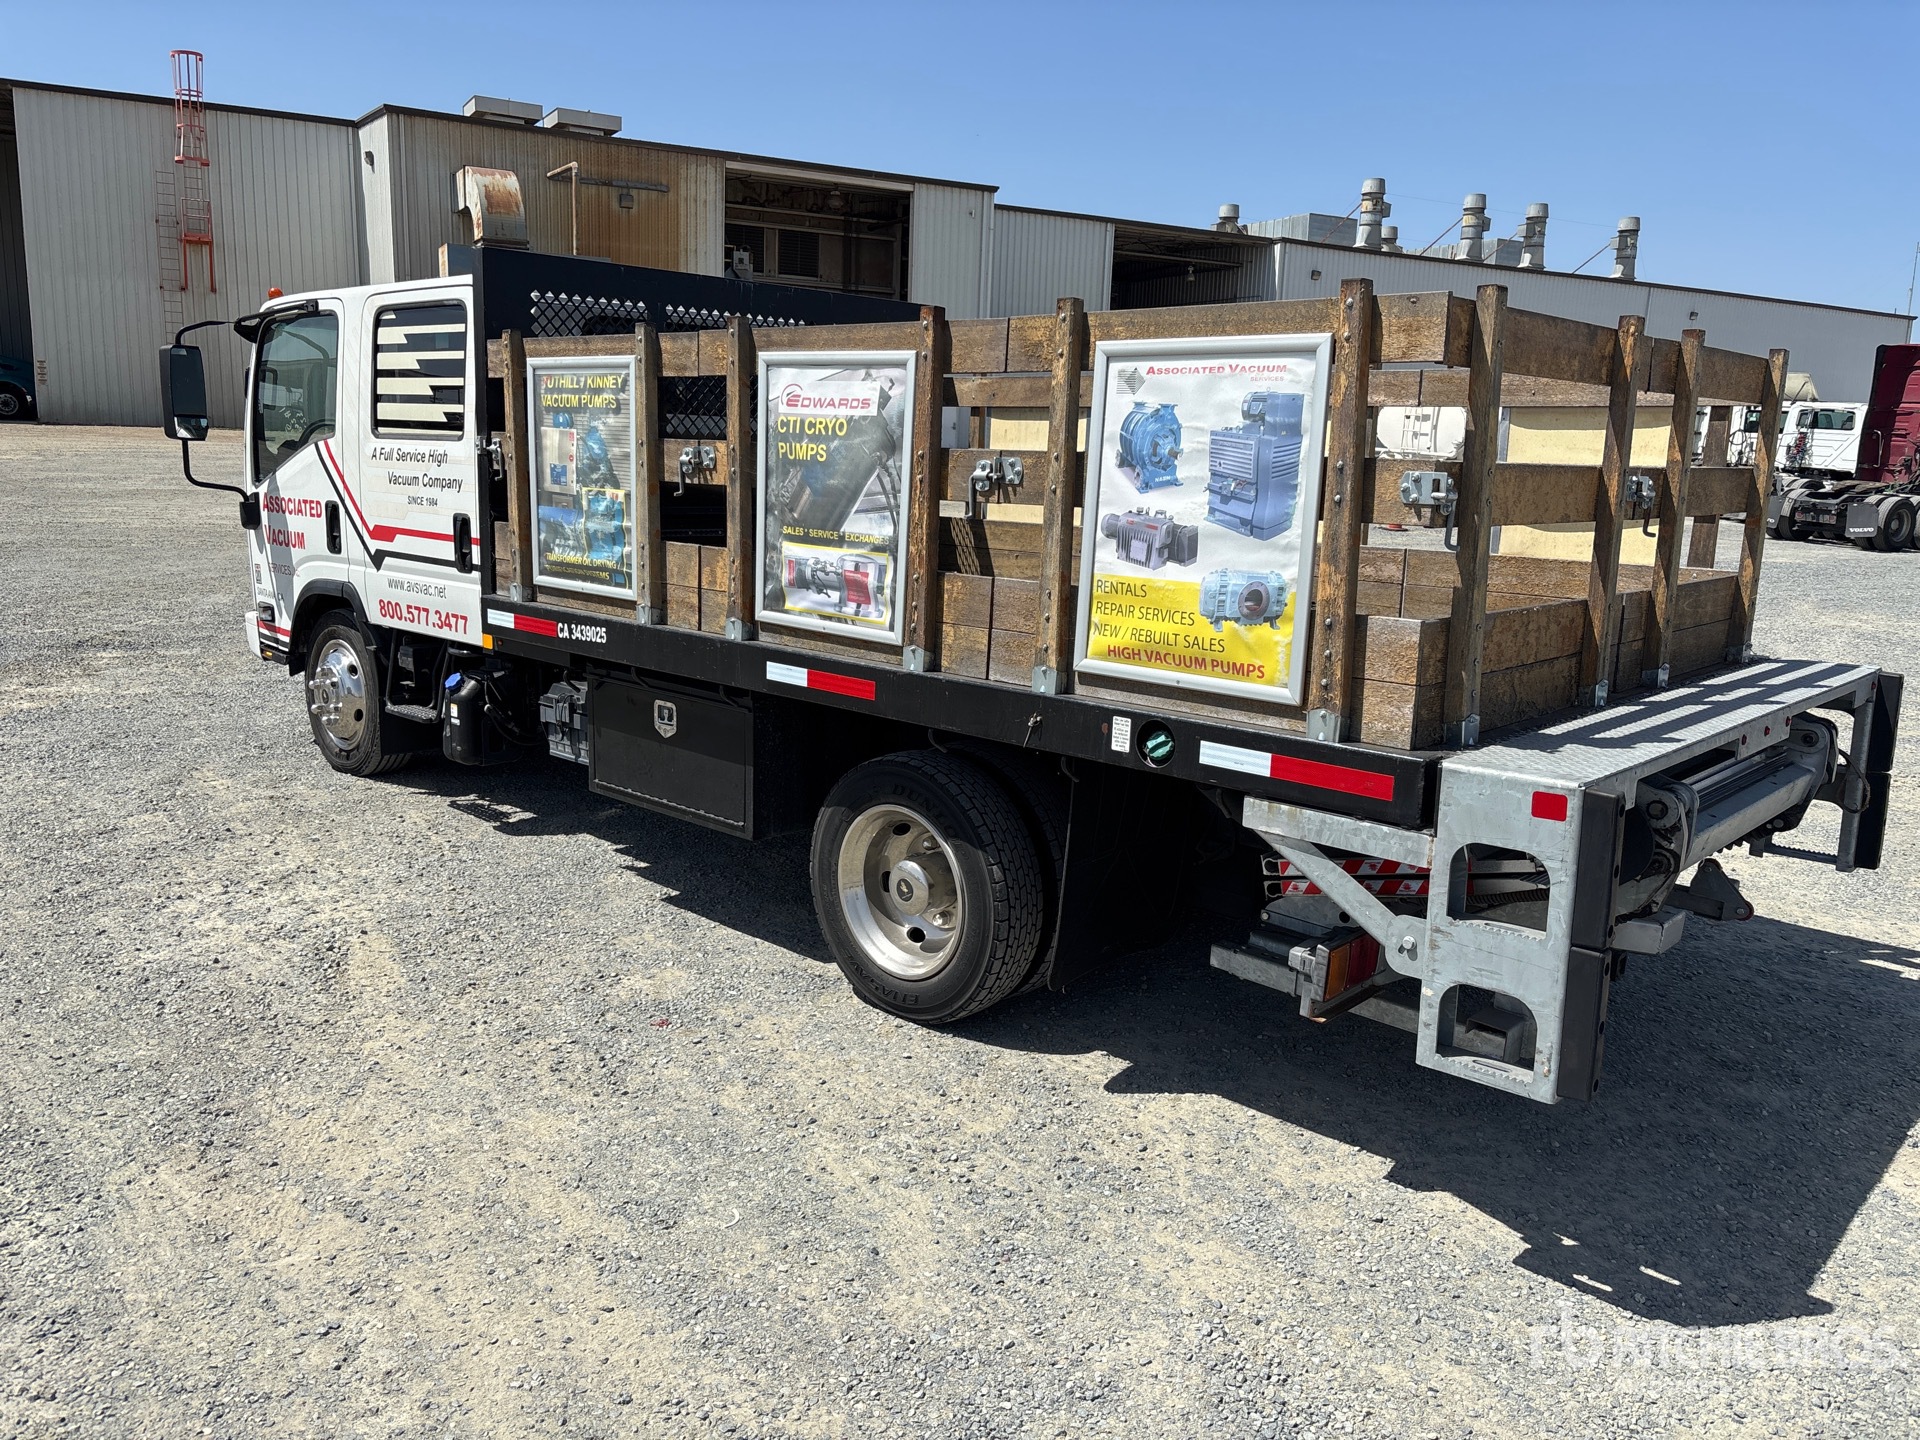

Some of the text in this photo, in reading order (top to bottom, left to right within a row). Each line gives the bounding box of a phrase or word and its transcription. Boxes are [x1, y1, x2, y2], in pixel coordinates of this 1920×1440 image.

[1146, 364, 1287, 375] ASSOCIATED VACUUM
[587, 374, 624, 389] KINNEY
[541, 394, 617, 409] VACUUM PUMPS
[785, 394, 872, 409] EDWARDS
[777, 416, 848, 436] CTI CRYO
[371, 447, 448, 467] A Full Service High
[778, 442, 827, 462] PUMPS
[387, 470, 463, 493] Vacuum Company
[262, 491, 323, 519] ASSOCIATED
[407, 495, 438, 507] SINCE 1984
[264, 524, 306, 550] VACUUM
[782, 525, 889, 545] SALES SERVICE EXCHANGES
[387, 577, 447, 599] www.avsvac.net
[1096, 579, 1148, 598] RENTALS
[378, 598, 469, 635] 800.577.3477
[1095, 601, 1196, 626] REPAIR SERVICES
[557, 622, 607, 643] CA 3439025
[1093, 622, 1122, 640] NEW
[1130, 627, 1180, 648] REBUILT
[1183, 634, 1225, 653] SALES
[1107, 645, 1266, 680] HIGH VACUUM PUMPS
